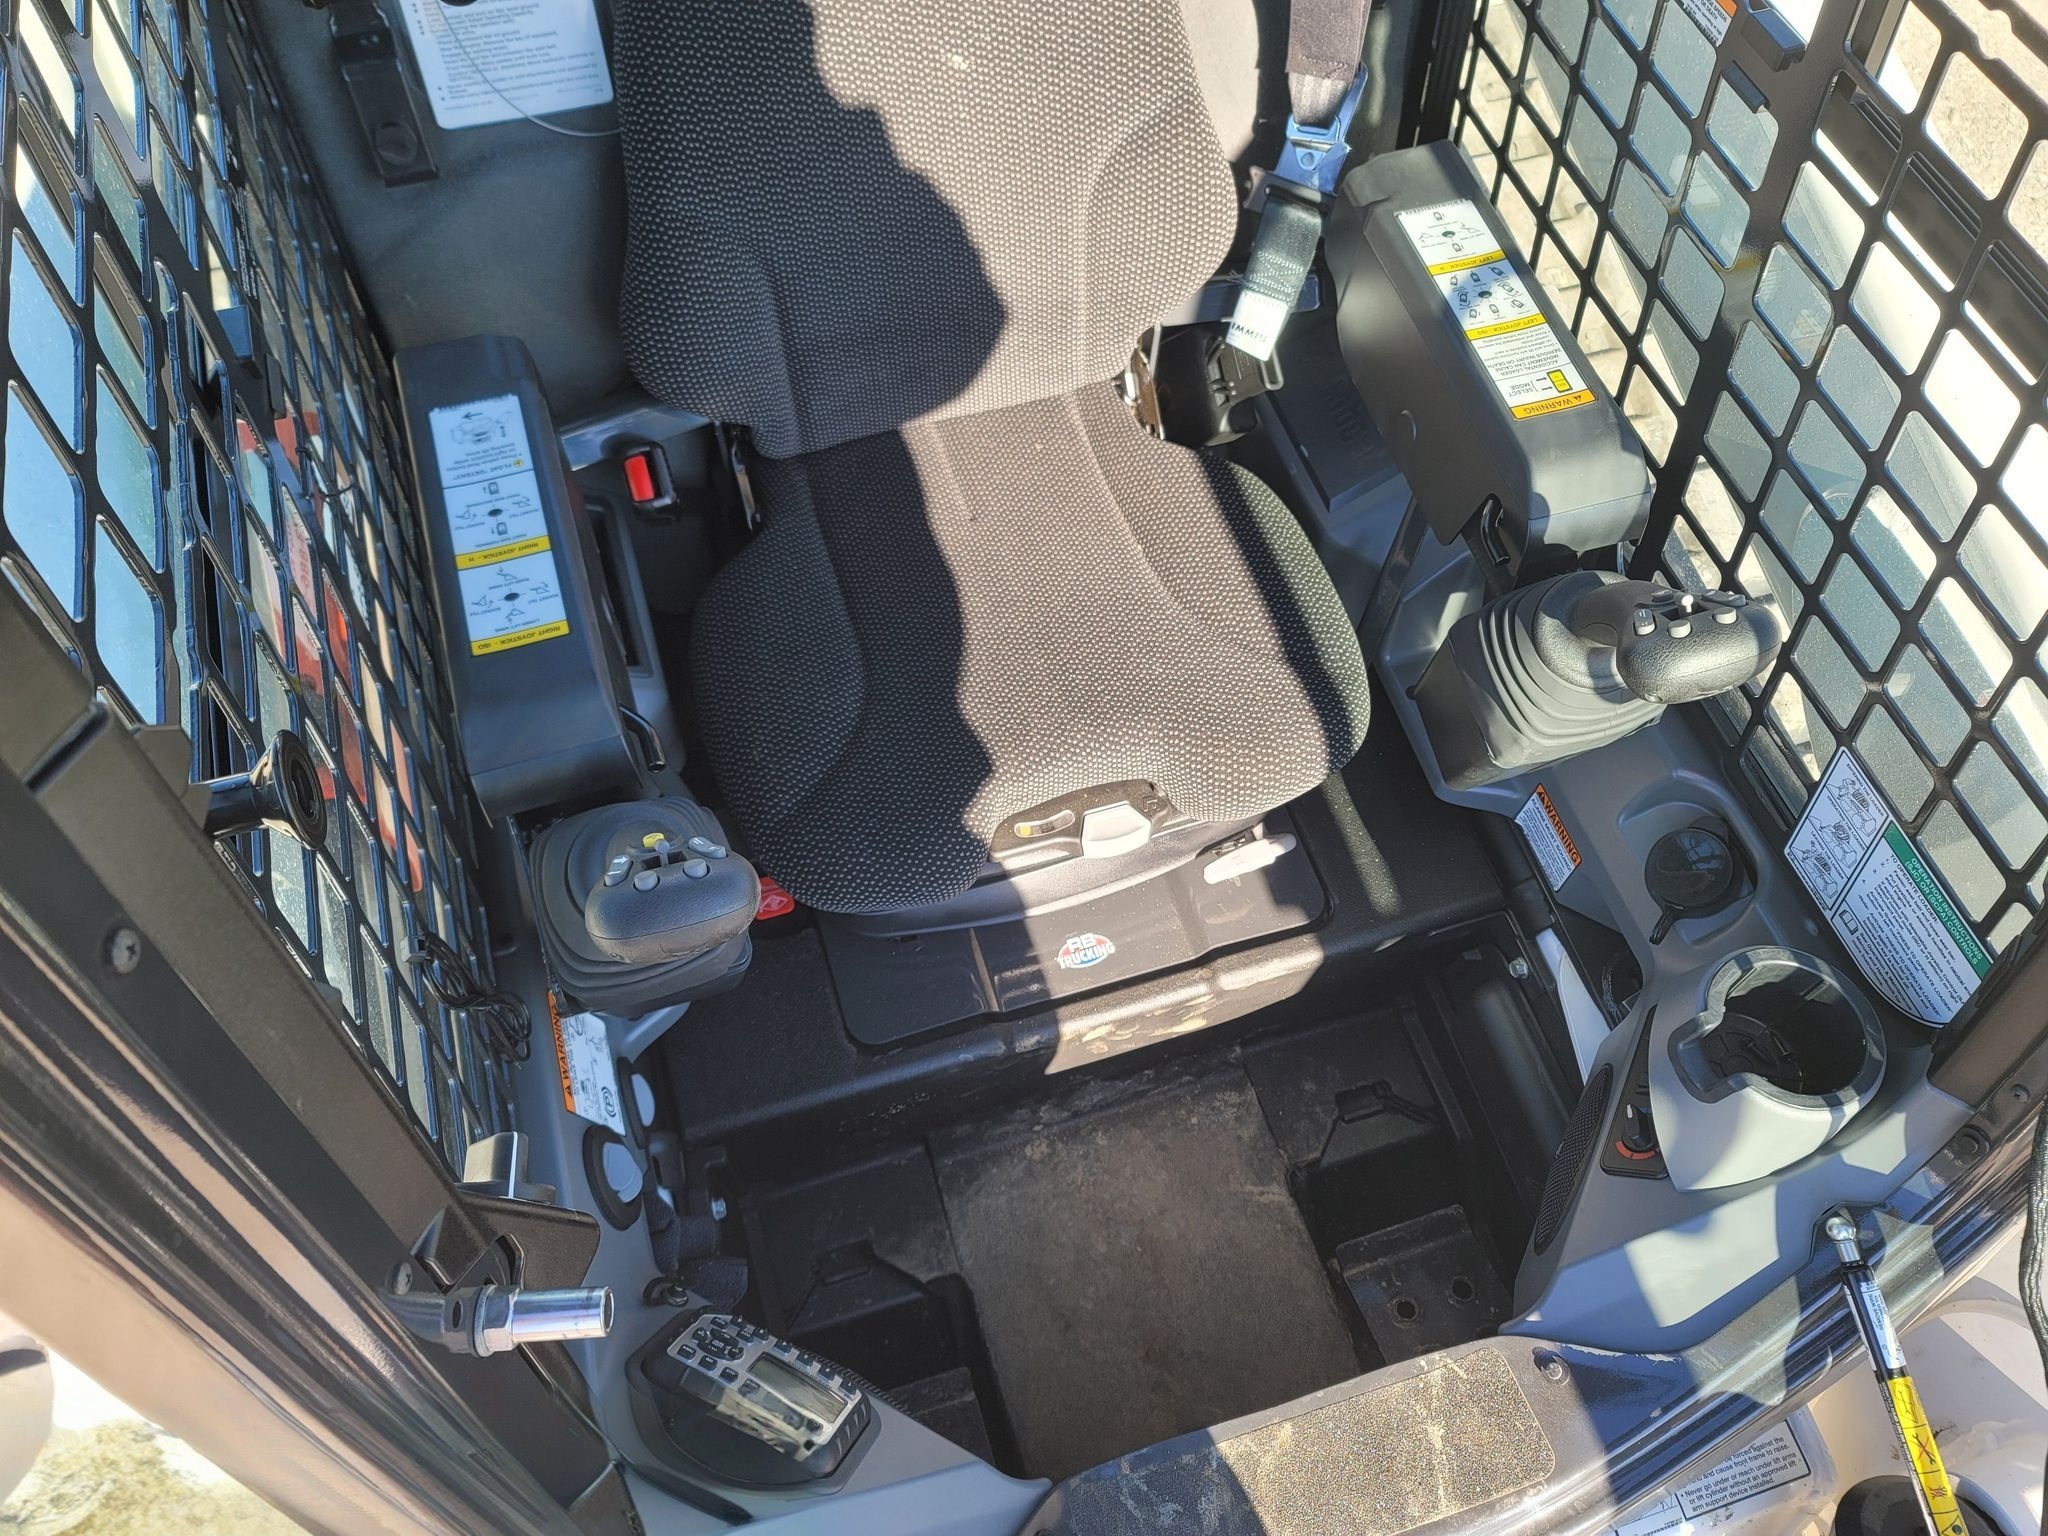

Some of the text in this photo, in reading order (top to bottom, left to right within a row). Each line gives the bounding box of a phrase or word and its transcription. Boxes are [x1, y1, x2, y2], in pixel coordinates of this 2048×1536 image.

[1491, 321, 1521, 331] JOYSTICK
[1514, 354, 1535, 362] INJURY
[1526, 354, 1559, 364] MOVEMENT
[1535, 348, 1561, 357] SERIOUS
[1494, 364, 1513, 372] CAUSE
[1499, 359, 1559, 376] ACCIDENTAL LOADER
[1507, 387, 1534, 397] SELECT
[1522, 398, 1572, 414] WARNING
[482, 547, 516, 559] JOYSTICK
[517, 541, 538, 551] RIGHT
[499, 631, 536, 644] JOYSTICK
[537, 625, 560, 635] RIGHT
[1846, 762, 1883, 817] ENTERING THE LOADER
[1530, 796, 1545, 823] ALARM
[1544, 822, 1556, 843] MUST
[1544, 800, 1578, 863] WARNING
[1826, 794, 1845, 822] OPERATING
[1851, 830, 1865, 851] LOADER
[1810, 830, 1824, 851] LEAVING
[1830, 860, 1844, 880] LOADER
[1884, 875, 1894, 890] start
[1890, 853, 1938, 924] TO OPERATE LOADER:
[1893, 869, 1948, 951] Fasten seat belt and lower seat
[1910, 856, 1982, 961] OPERATION INSTRUCTIONS
[1919, 880, 1929, 895] OR
[1946, 919, 1978, 966] CONTROLS
[1869, 889, 1884, 913] Activate
[1883, 911, 1895, 929] Green
[1910, 950, 1916, 960] TO
[1915, 958, 1935, 988] OPERATE
[1056, 942, 1116, 969] TRUCKING
[1714, 1463, 1734, 1474] cause
[1733, 1457, 1748, 1467] front
[1747, 1451, 1766, 1462] frame
[1772, 1442, 1790, 1453] raise.
[1731, 1447, 1752, 1460] forced
[1773, 1435, 1784, 1444] the
[1684, 1485, 1703, 1497] Never
[1702, 1482, 1712, 1490] go
[1711, 1475, 1730, 1487] under
[1729, 1472, 1738, 1480] or
[1737, 1466, 1754, 1477] reach
[1754, 1459, 1772, 1471] under
[1771, 1456, 1781, 1464] lift
[1780, 1450, 1796, 1461] arms
[1696, 1494, 1705, 1502] lift
[1704, 1485, 1729, 1499] cylinder
[1728, 1477, 1752, 1490] without
[1751, 1473, 1760, 1481] an
[1759, 1463, 1788, 1478] approved
[1787, 1459, 1797, 1467] lift
[1691, 1476, 1775, 1512] arm support device installed.
